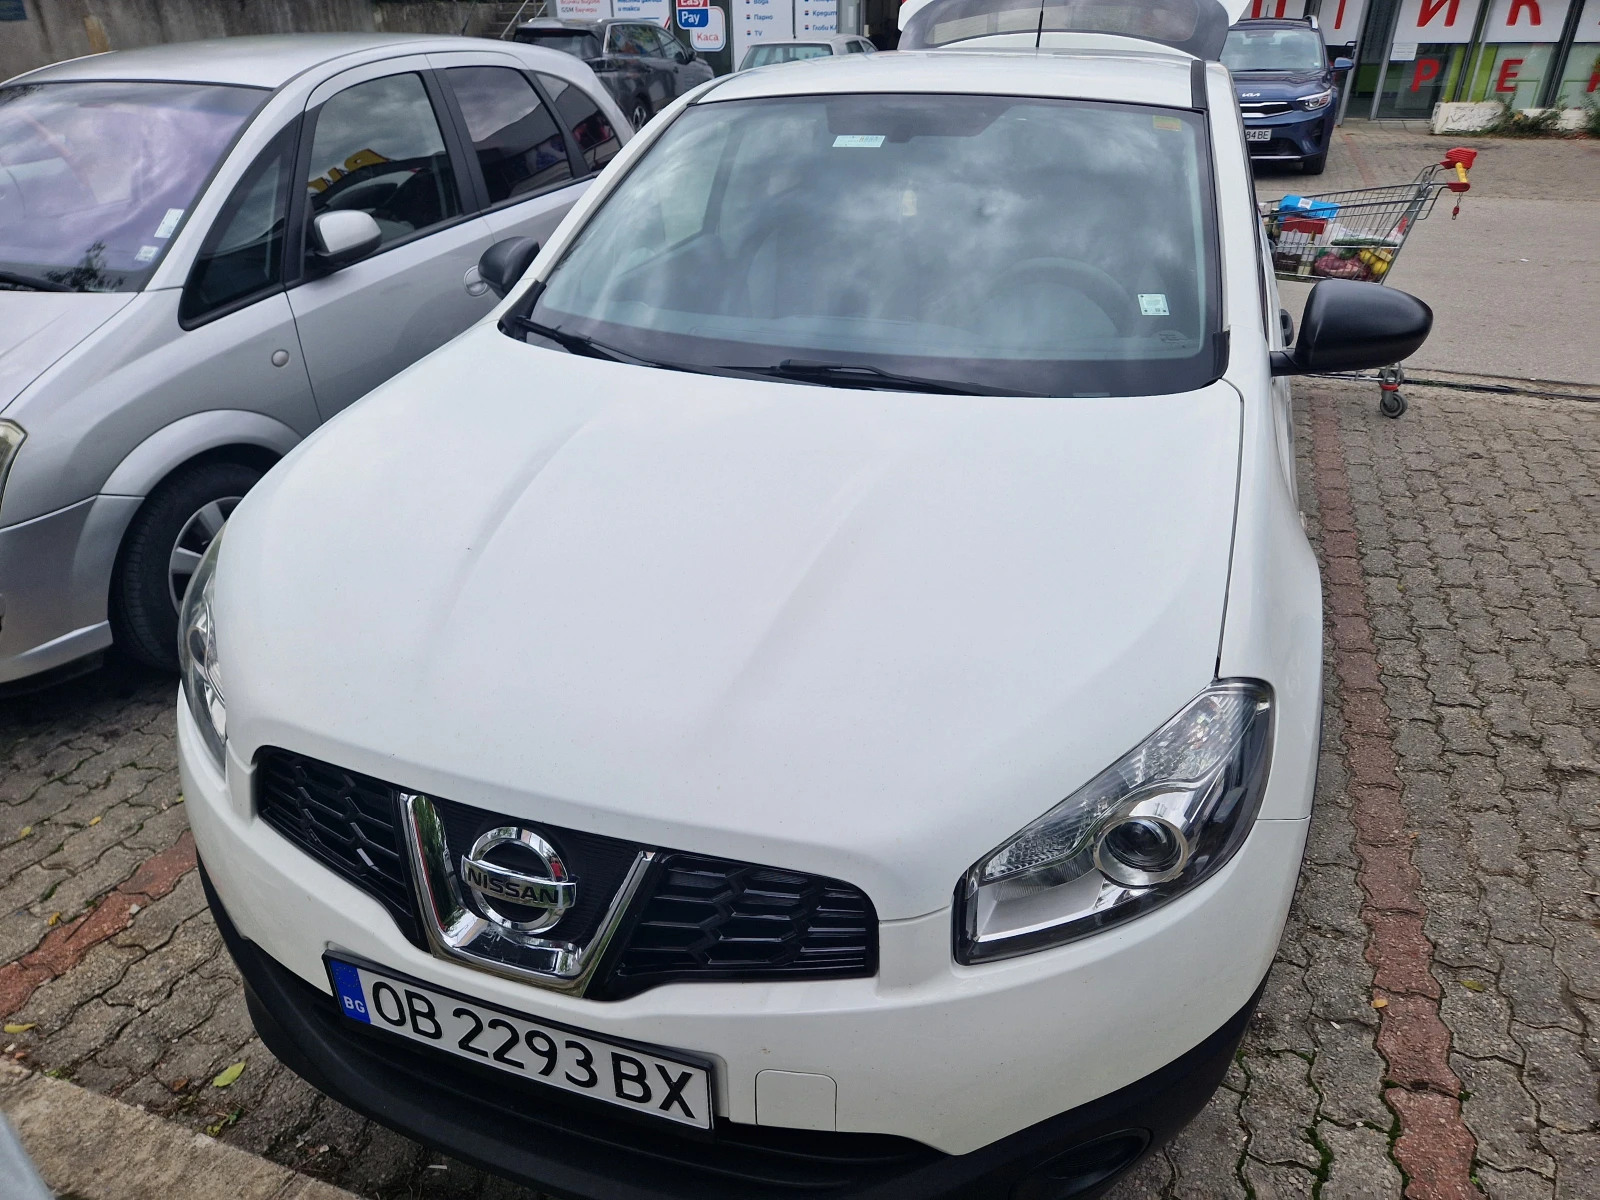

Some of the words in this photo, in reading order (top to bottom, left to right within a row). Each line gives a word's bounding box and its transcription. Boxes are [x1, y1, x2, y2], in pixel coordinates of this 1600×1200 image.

[682, 11, 700, 25] Pay
[696, 32, 720, 41] Каса
[467, 867, 559, 905] NISSAN
[342, 994, 365, 1015] BG
[372, 981, 443, 1040] OB
[452, 1007, 598, 1088] 2293
[611, 1051, 697, 1119] BX
